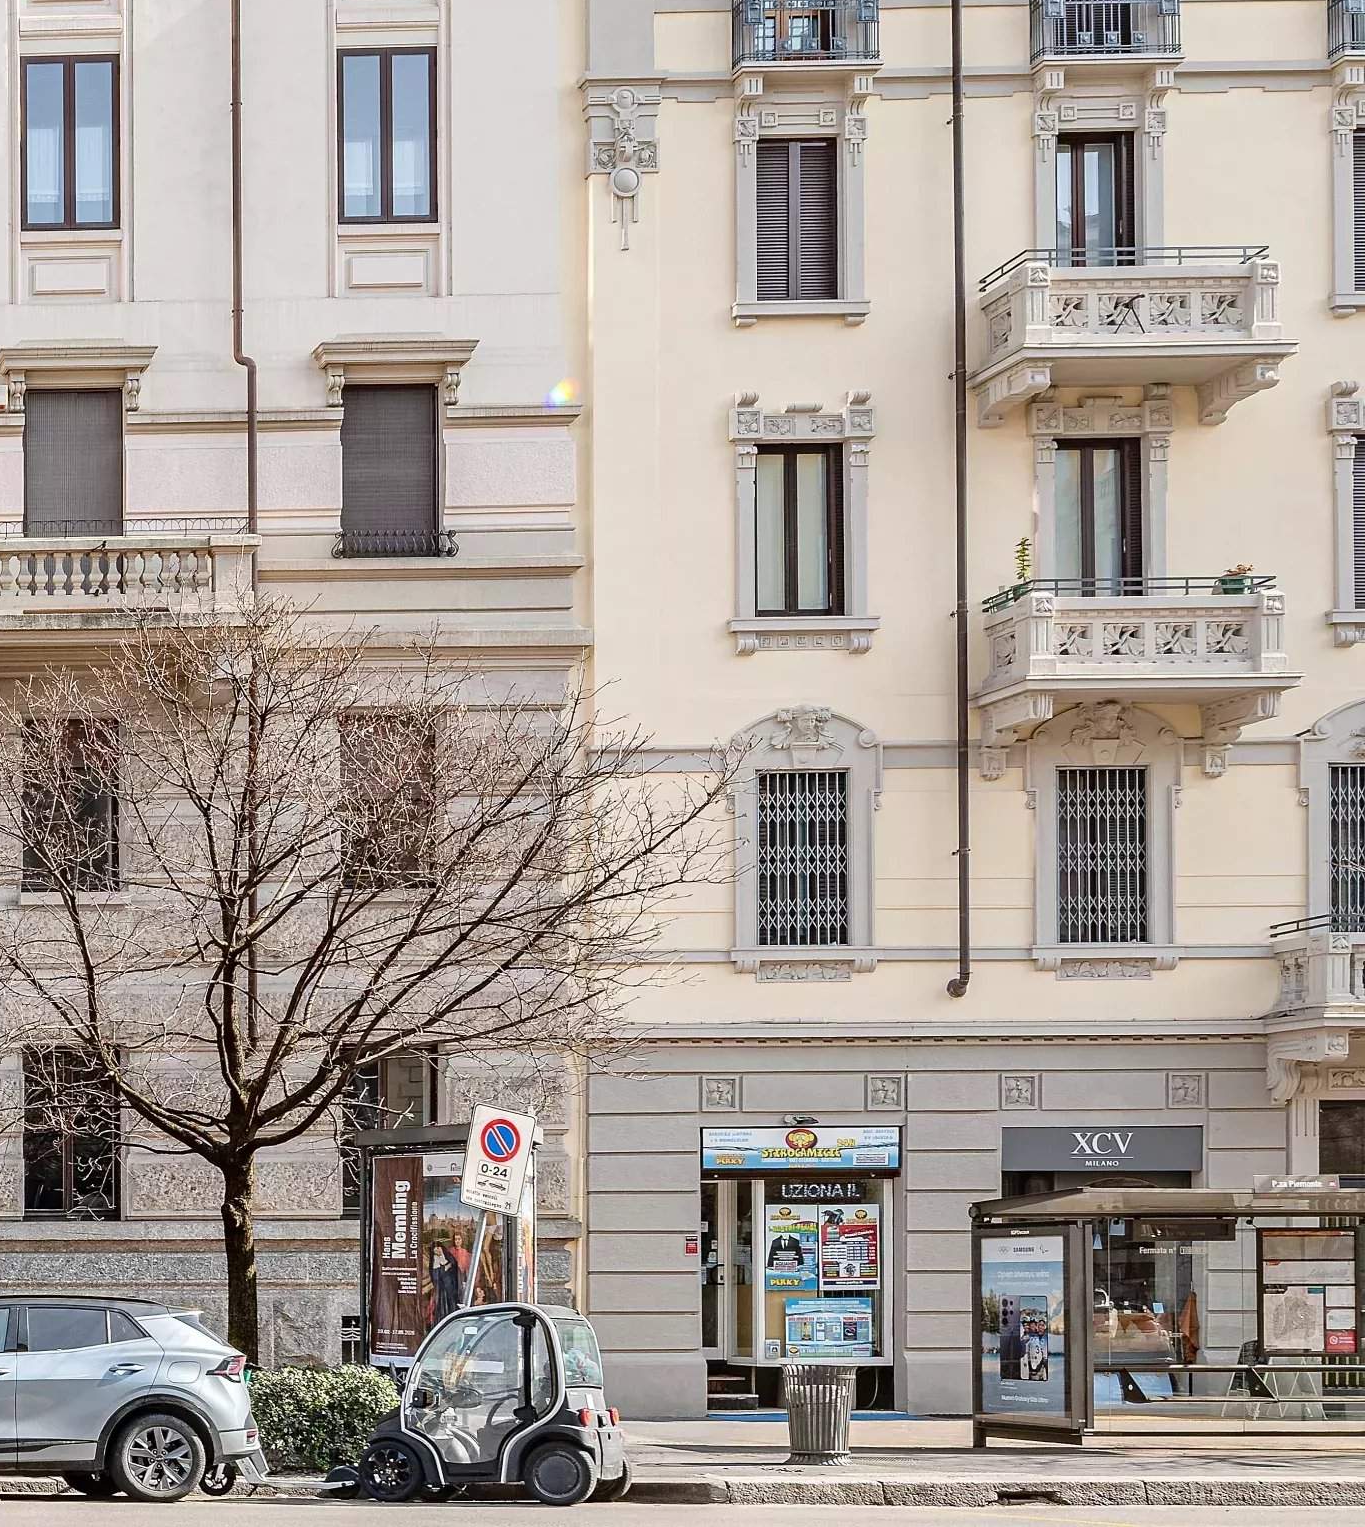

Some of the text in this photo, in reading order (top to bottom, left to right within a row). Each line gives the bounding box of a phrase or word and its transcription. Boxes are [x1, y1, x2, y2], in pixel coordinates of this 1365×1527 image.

[1070, 1132, 1134, 1154] XCV
[481, 1163, 508, 1178] 0-24
[391, 1180, 411, 1259] Memling
[382, 1236, 391, 1259] Hans
[1139, 1246, 1167, 1254] Fermata
